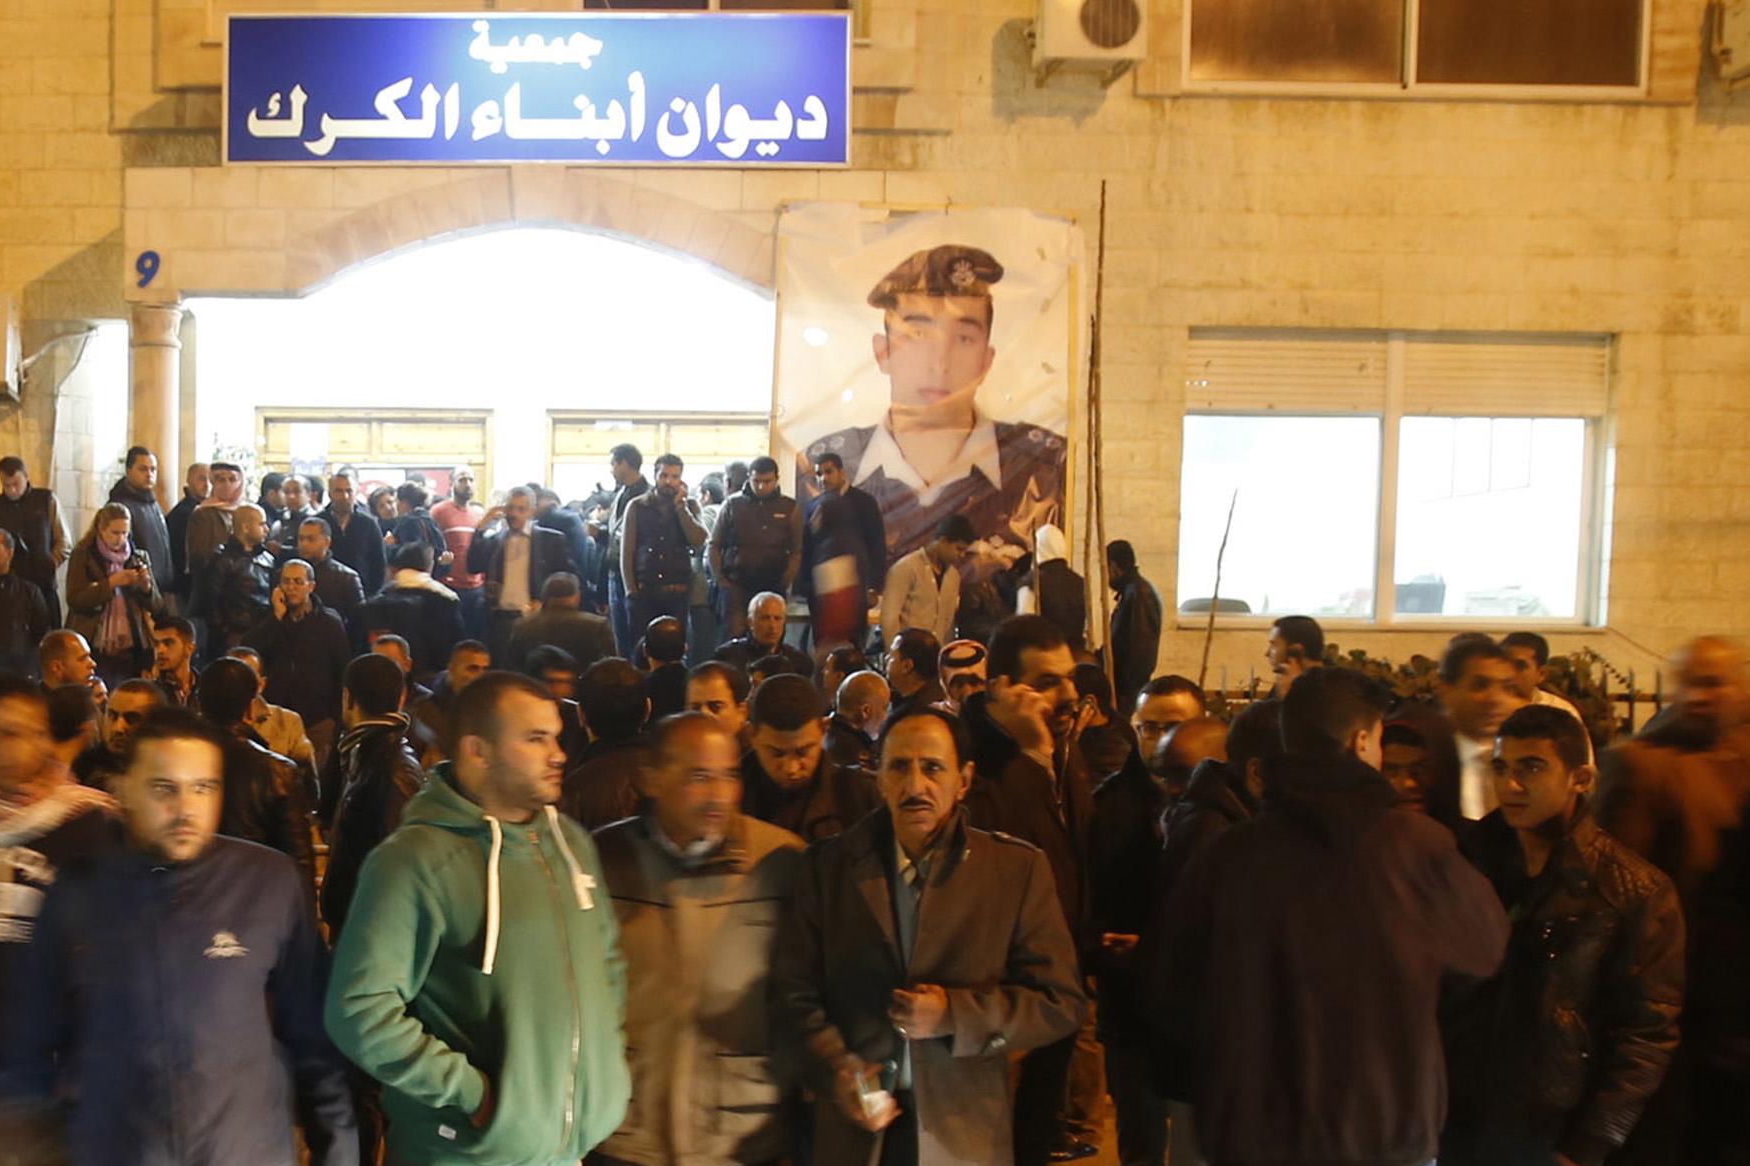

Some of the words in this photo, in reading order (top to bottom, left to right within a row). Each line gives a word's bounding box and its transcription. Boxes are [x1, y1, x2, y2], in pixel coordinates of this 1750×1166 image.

[467, 19, 605, 75] جمعية
[247, 77, 461, 156] الكرك
[470, 70, 647, 155] أبناء
[655, 83, 829, 159] ديوان
[135, 250, 160, 288] 9
